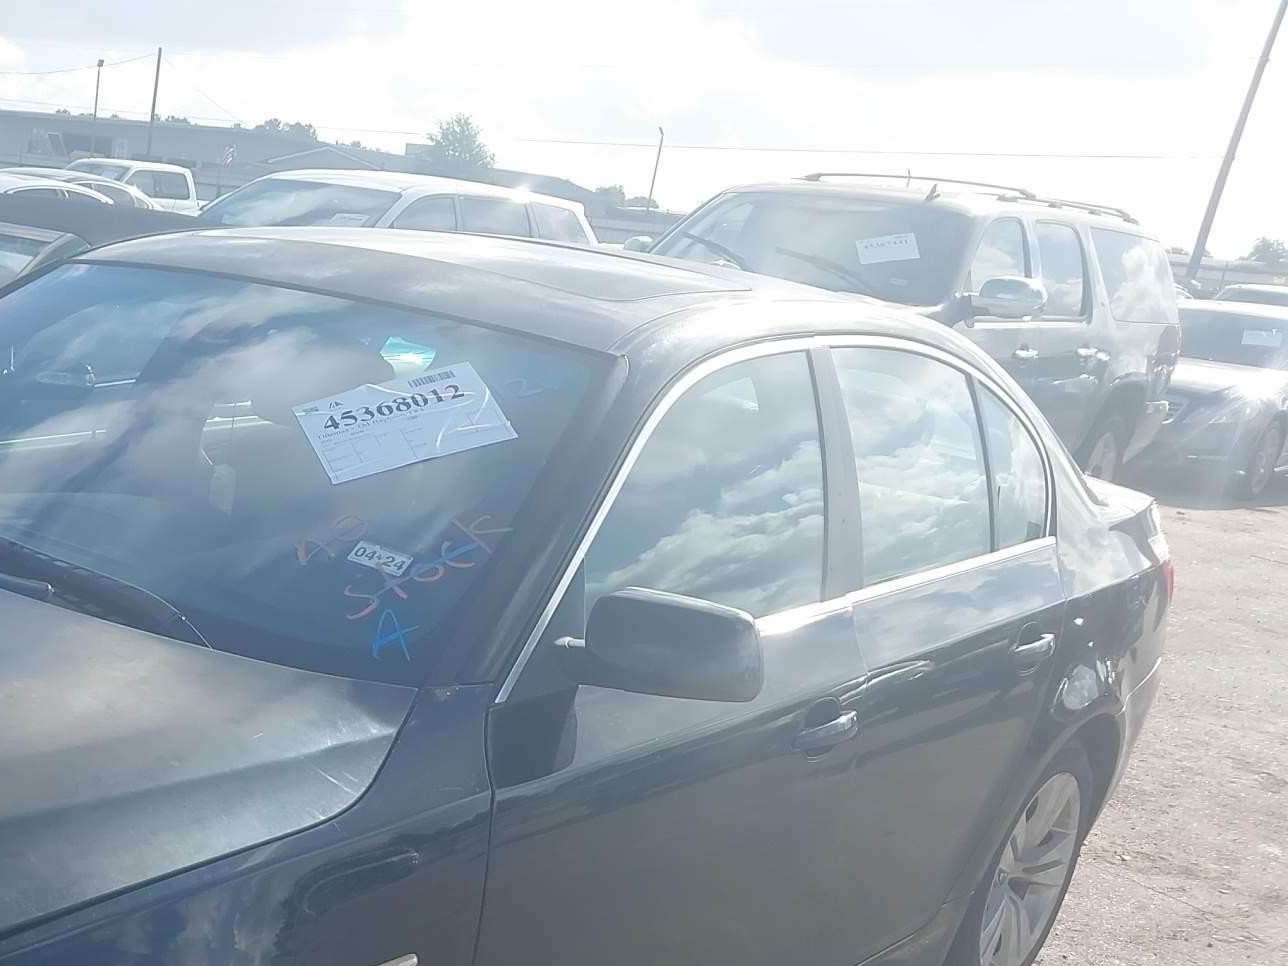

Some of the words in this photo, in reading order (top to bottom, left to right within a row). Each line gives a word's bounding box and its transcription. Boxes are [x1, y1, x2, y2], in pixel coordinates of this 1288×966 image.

[322, 383, 465, 431] 45368012
[353, 546, 376, 562] 04
[382, 554, 406, 571] 24
[371, 608, 420, 662] A
